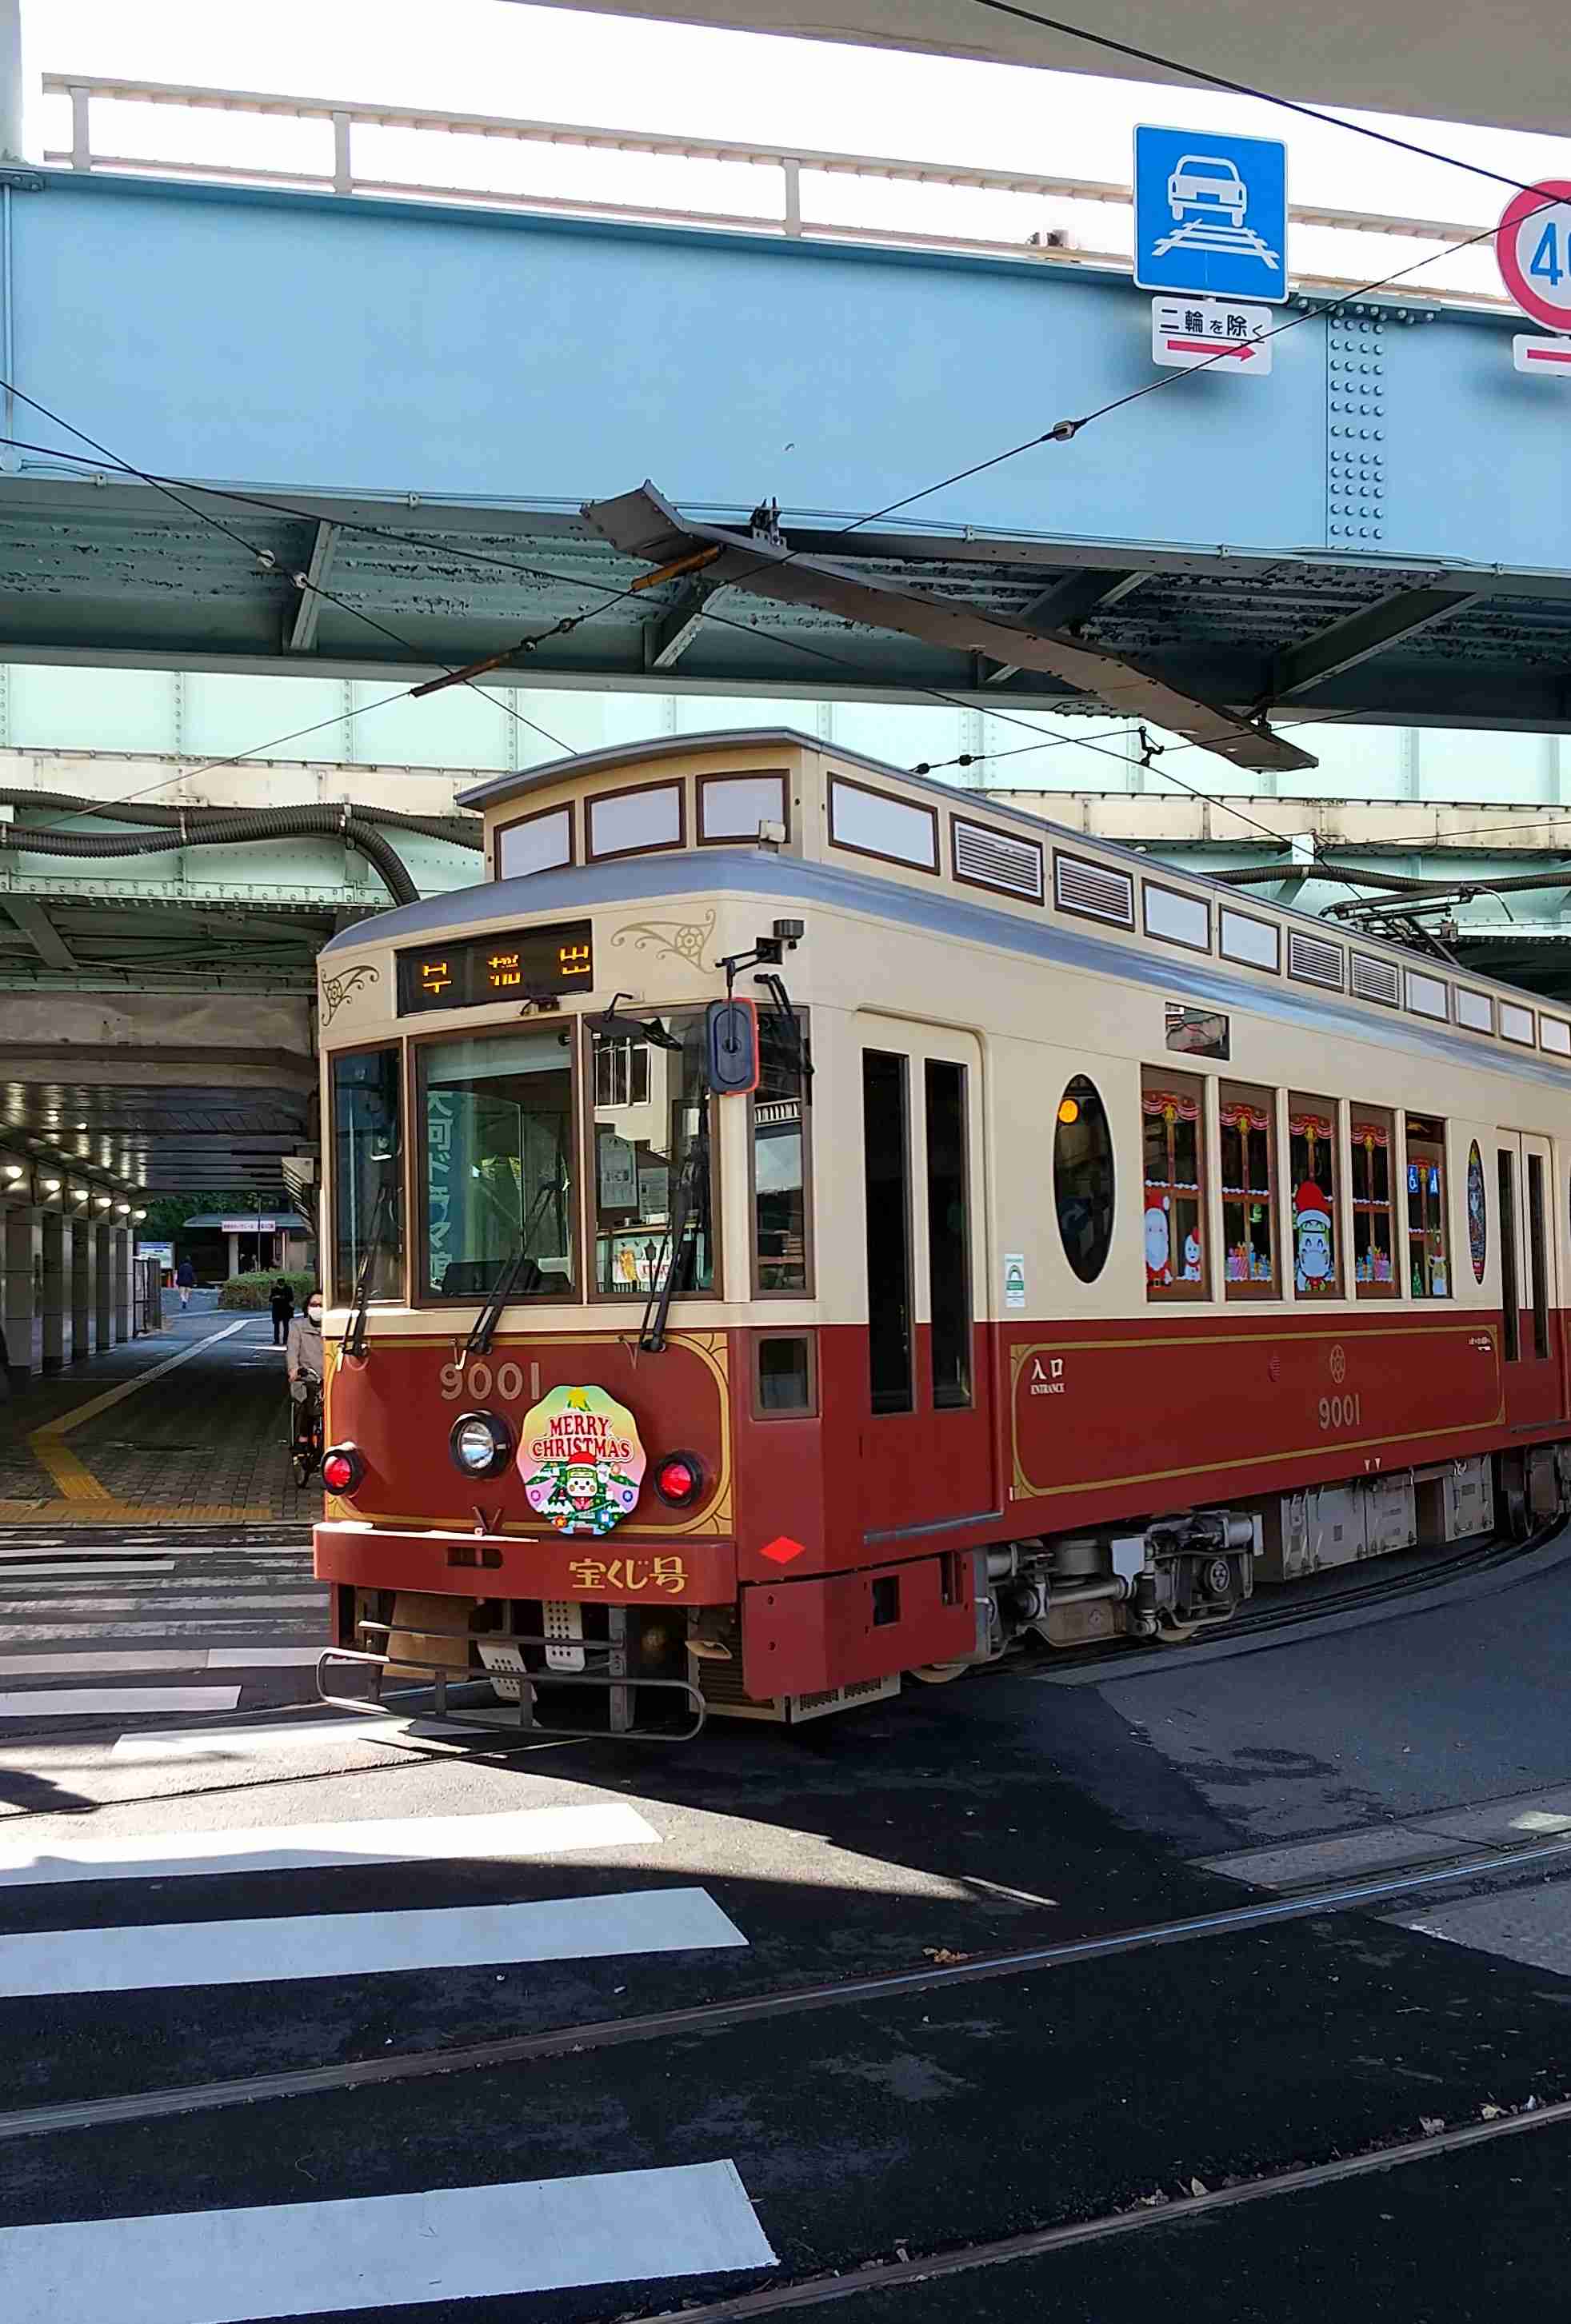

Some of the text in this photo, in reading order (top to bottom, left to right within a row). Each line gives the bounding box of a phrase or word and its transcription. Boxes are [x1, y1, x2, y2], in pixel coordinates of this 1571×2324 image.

[1529, 222, 1571, 286] 4
[1160, 308, 1263, 338] 二輪を除く
[441, 1361, 541, 1400] 9001
[1031, 1358, 1063, 1380] 入口
[1029, 1383, 1065, 1395] ENTRANCE
[550, 1414, 610, 1438] MERRY
[1319, 1393, 1360, 1429] 9001
[532, 1437, 630, 1458] CHRISTMAS
[569, 1555, 689, 1594] 宝くじ号
